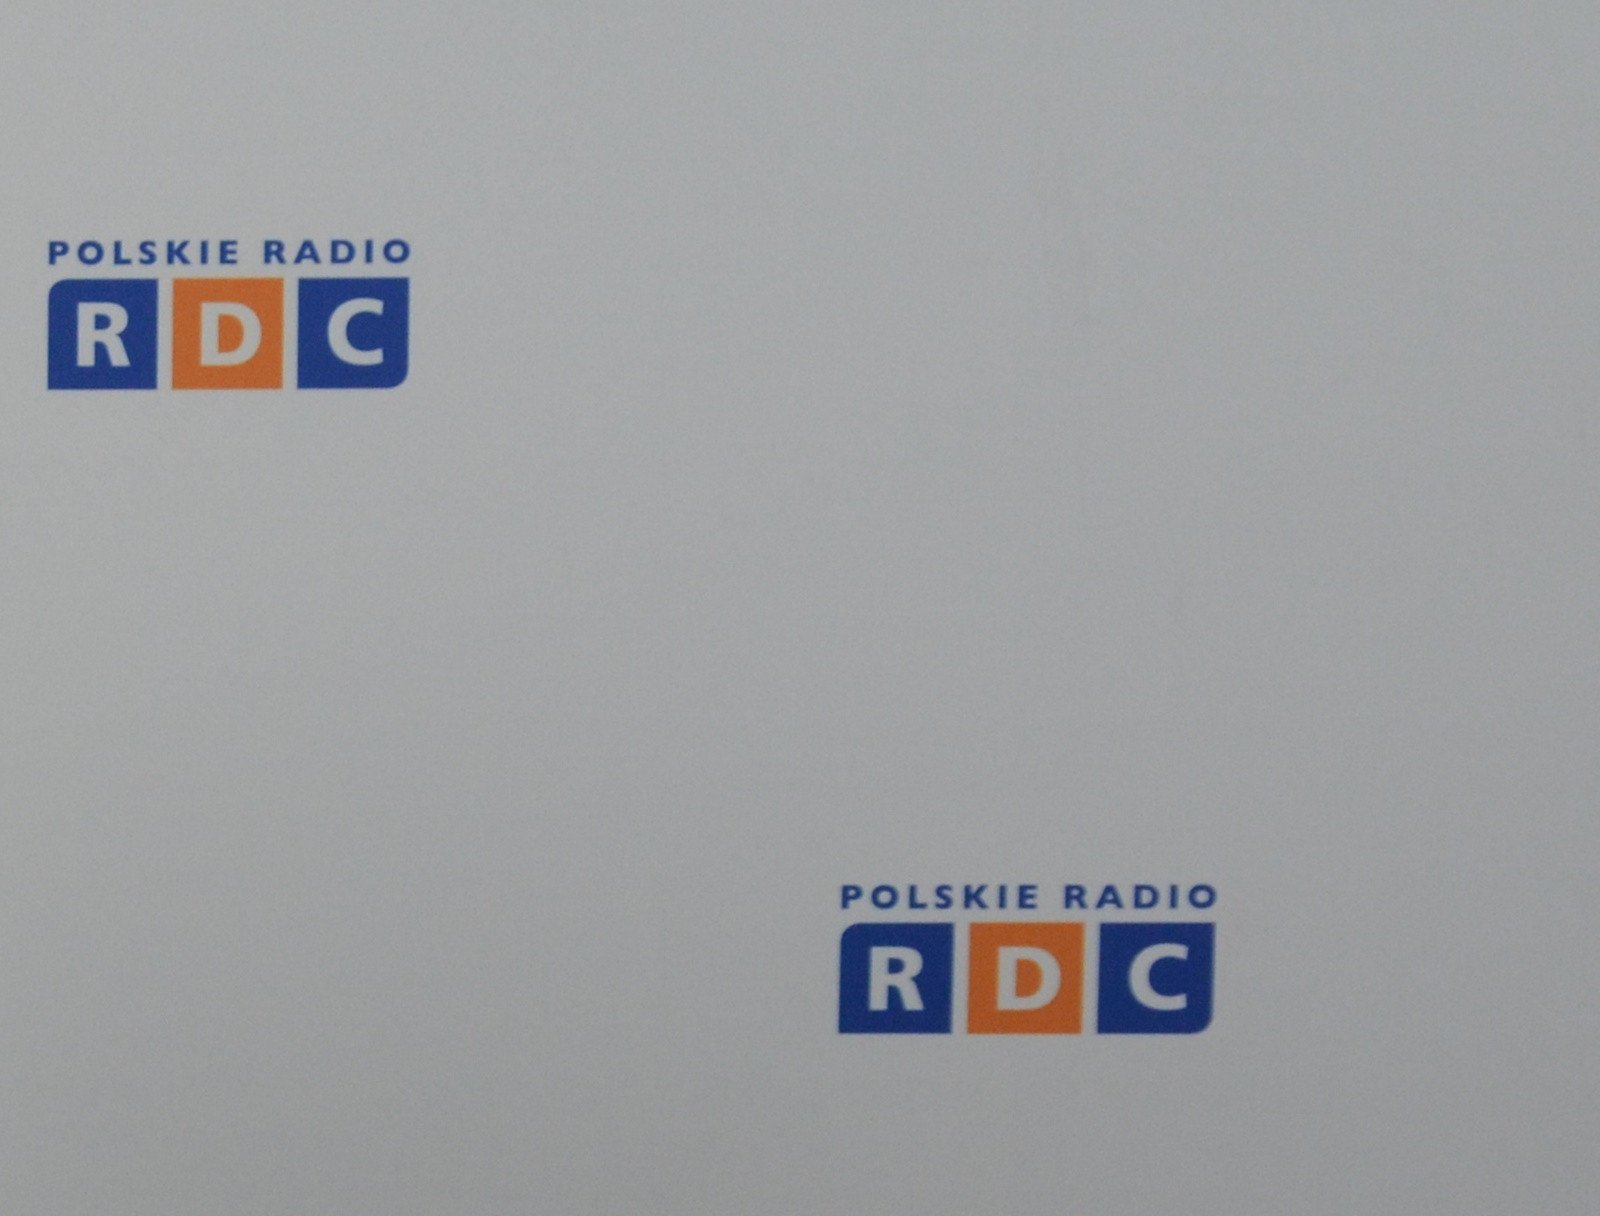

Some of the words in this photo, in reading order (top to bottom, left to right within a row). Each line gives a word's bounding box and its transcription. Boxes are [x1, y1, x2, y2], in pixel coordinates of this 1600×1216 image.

[47, 239, 238, 267] POLSKIE
[262, 238, 412, 267] RADIO
[78, 299, 382, 367] RDC
[839, 883, 1038, 912] POLSKIE
[1062, 883, 1217, 912] RADIO
[870, 944, 1186, 1011] RDC
